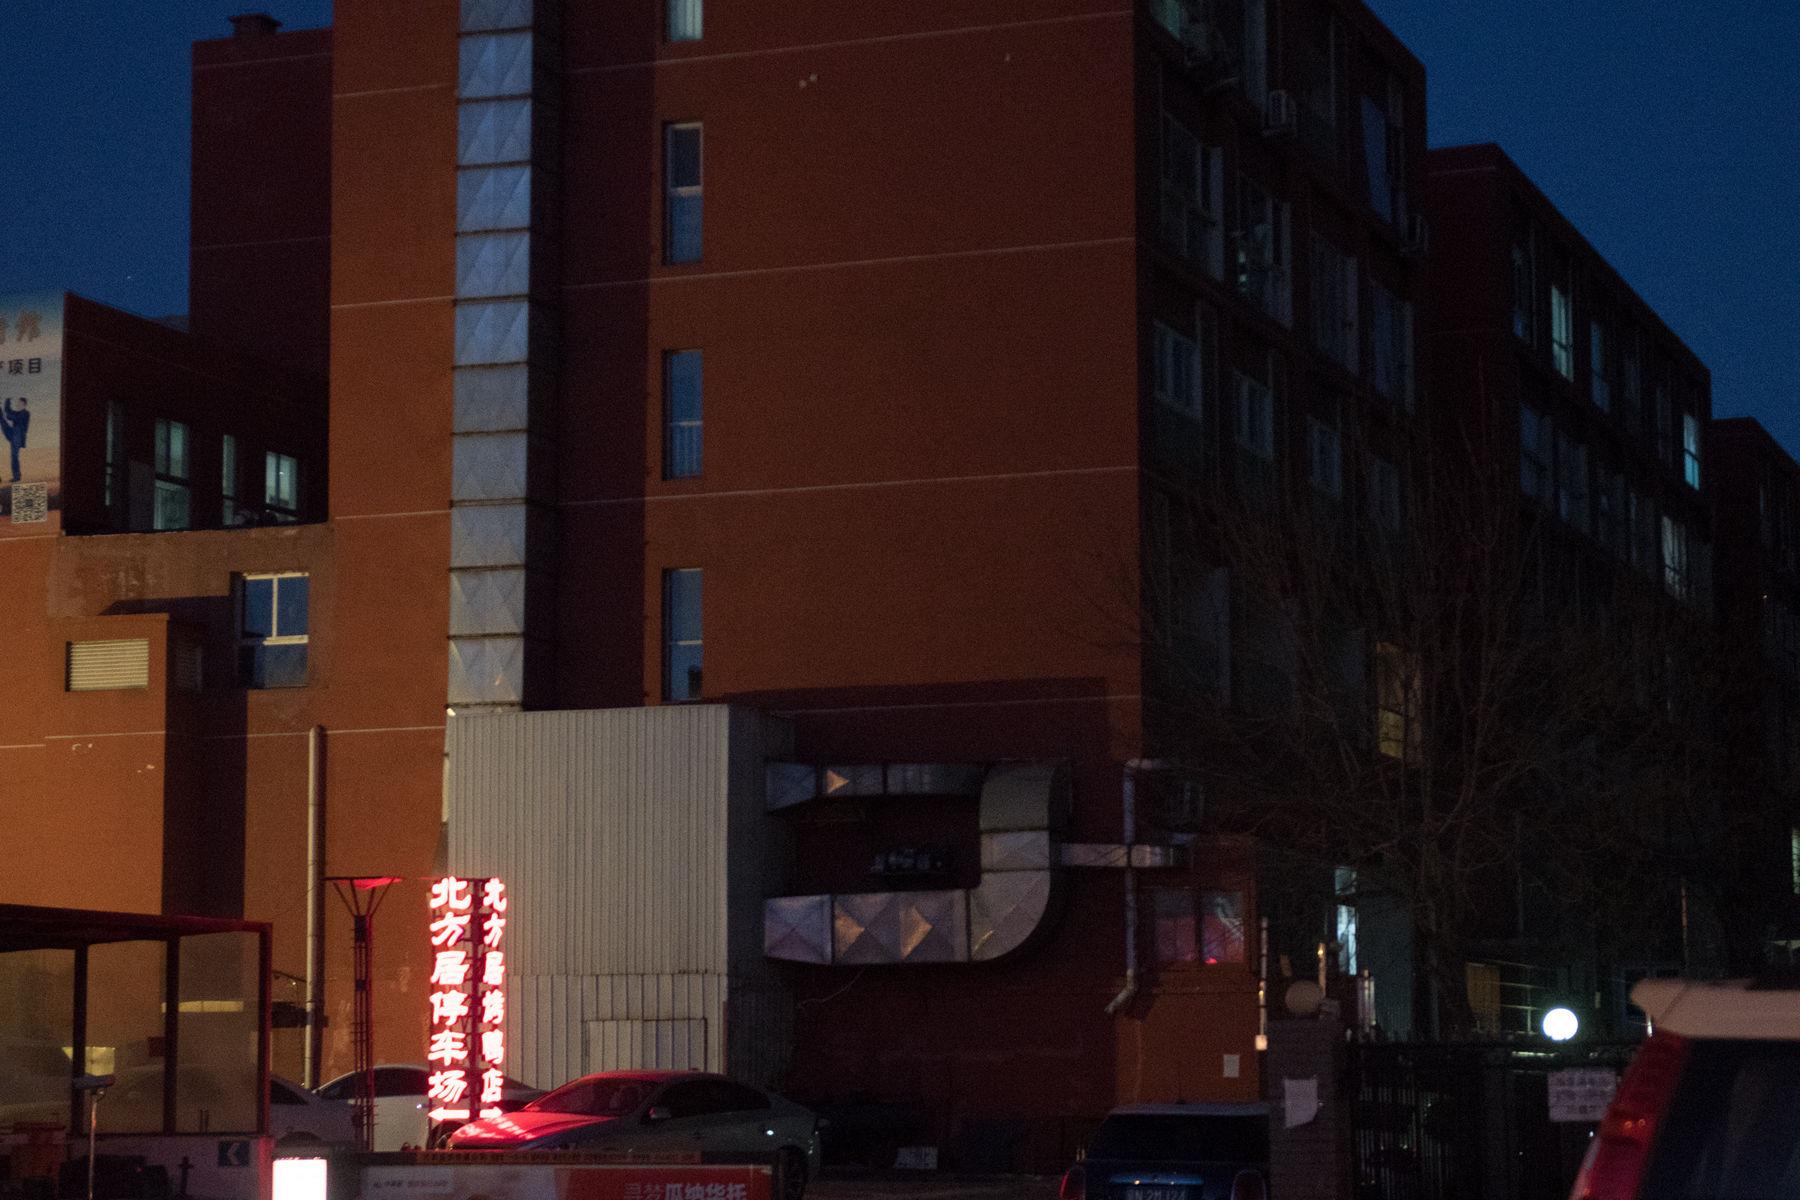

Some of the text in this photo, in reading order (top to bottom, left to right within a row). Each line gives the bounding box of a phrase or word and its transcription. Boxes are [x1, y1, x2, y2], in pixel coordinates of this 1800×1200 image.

[0, 358, 41, 374] 项目
[429, 876, 471, 1102] 北方居停车场
[482, 877, 507, 1102] 北方居烤鸭店
